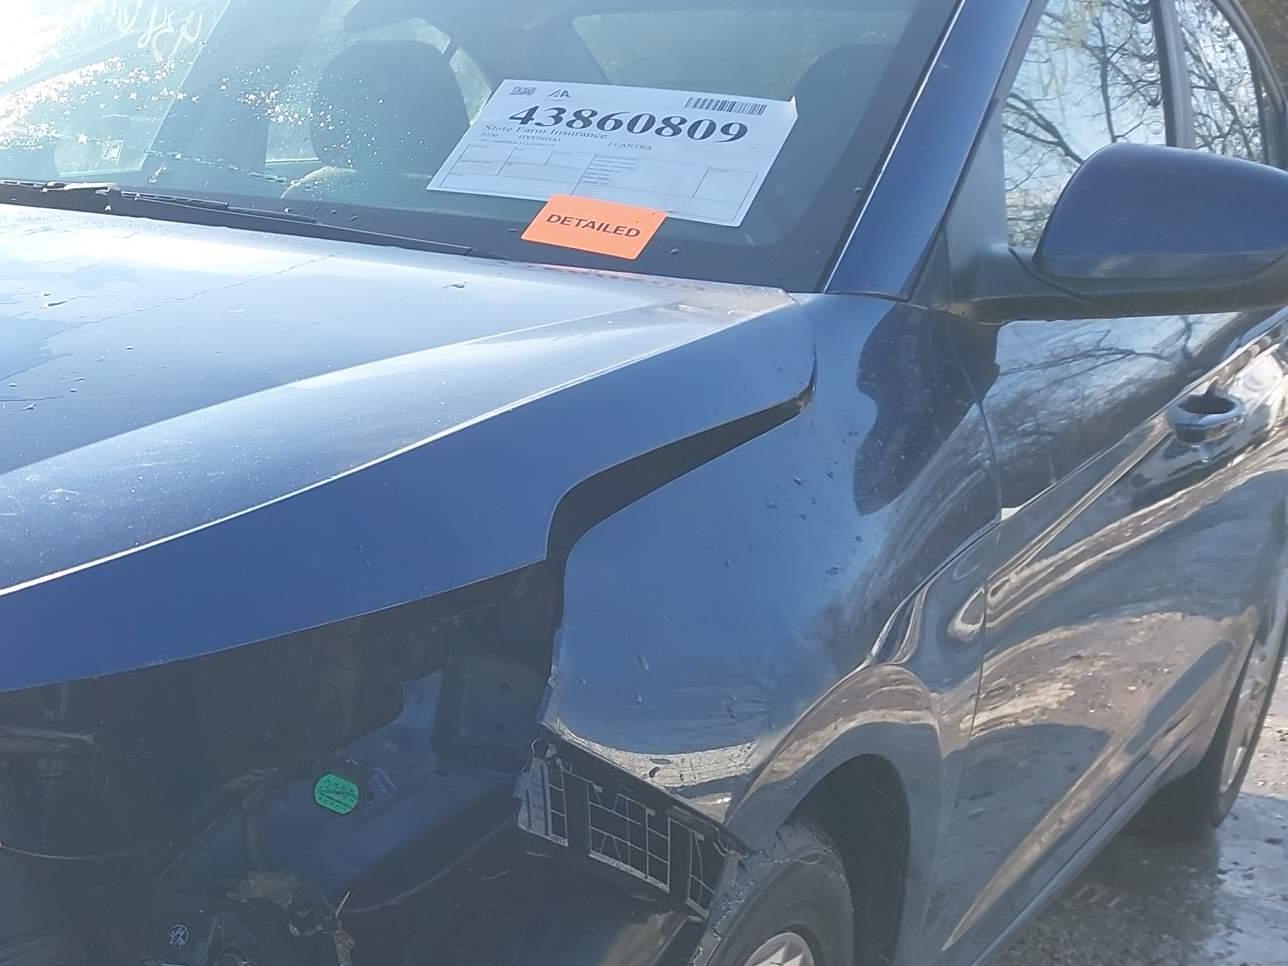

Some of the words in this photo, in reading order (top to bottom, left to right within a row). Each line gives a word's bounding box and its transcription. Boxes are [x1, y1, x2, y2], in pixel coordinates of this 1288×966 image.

[483, 124, 513, 132] State
[516, 126, 546, 135] Farm
[554, 129, 609, 140] Insurance
[509, 105, 749, 143] 43860809
[546, 213, 641, 239] DETAILED
